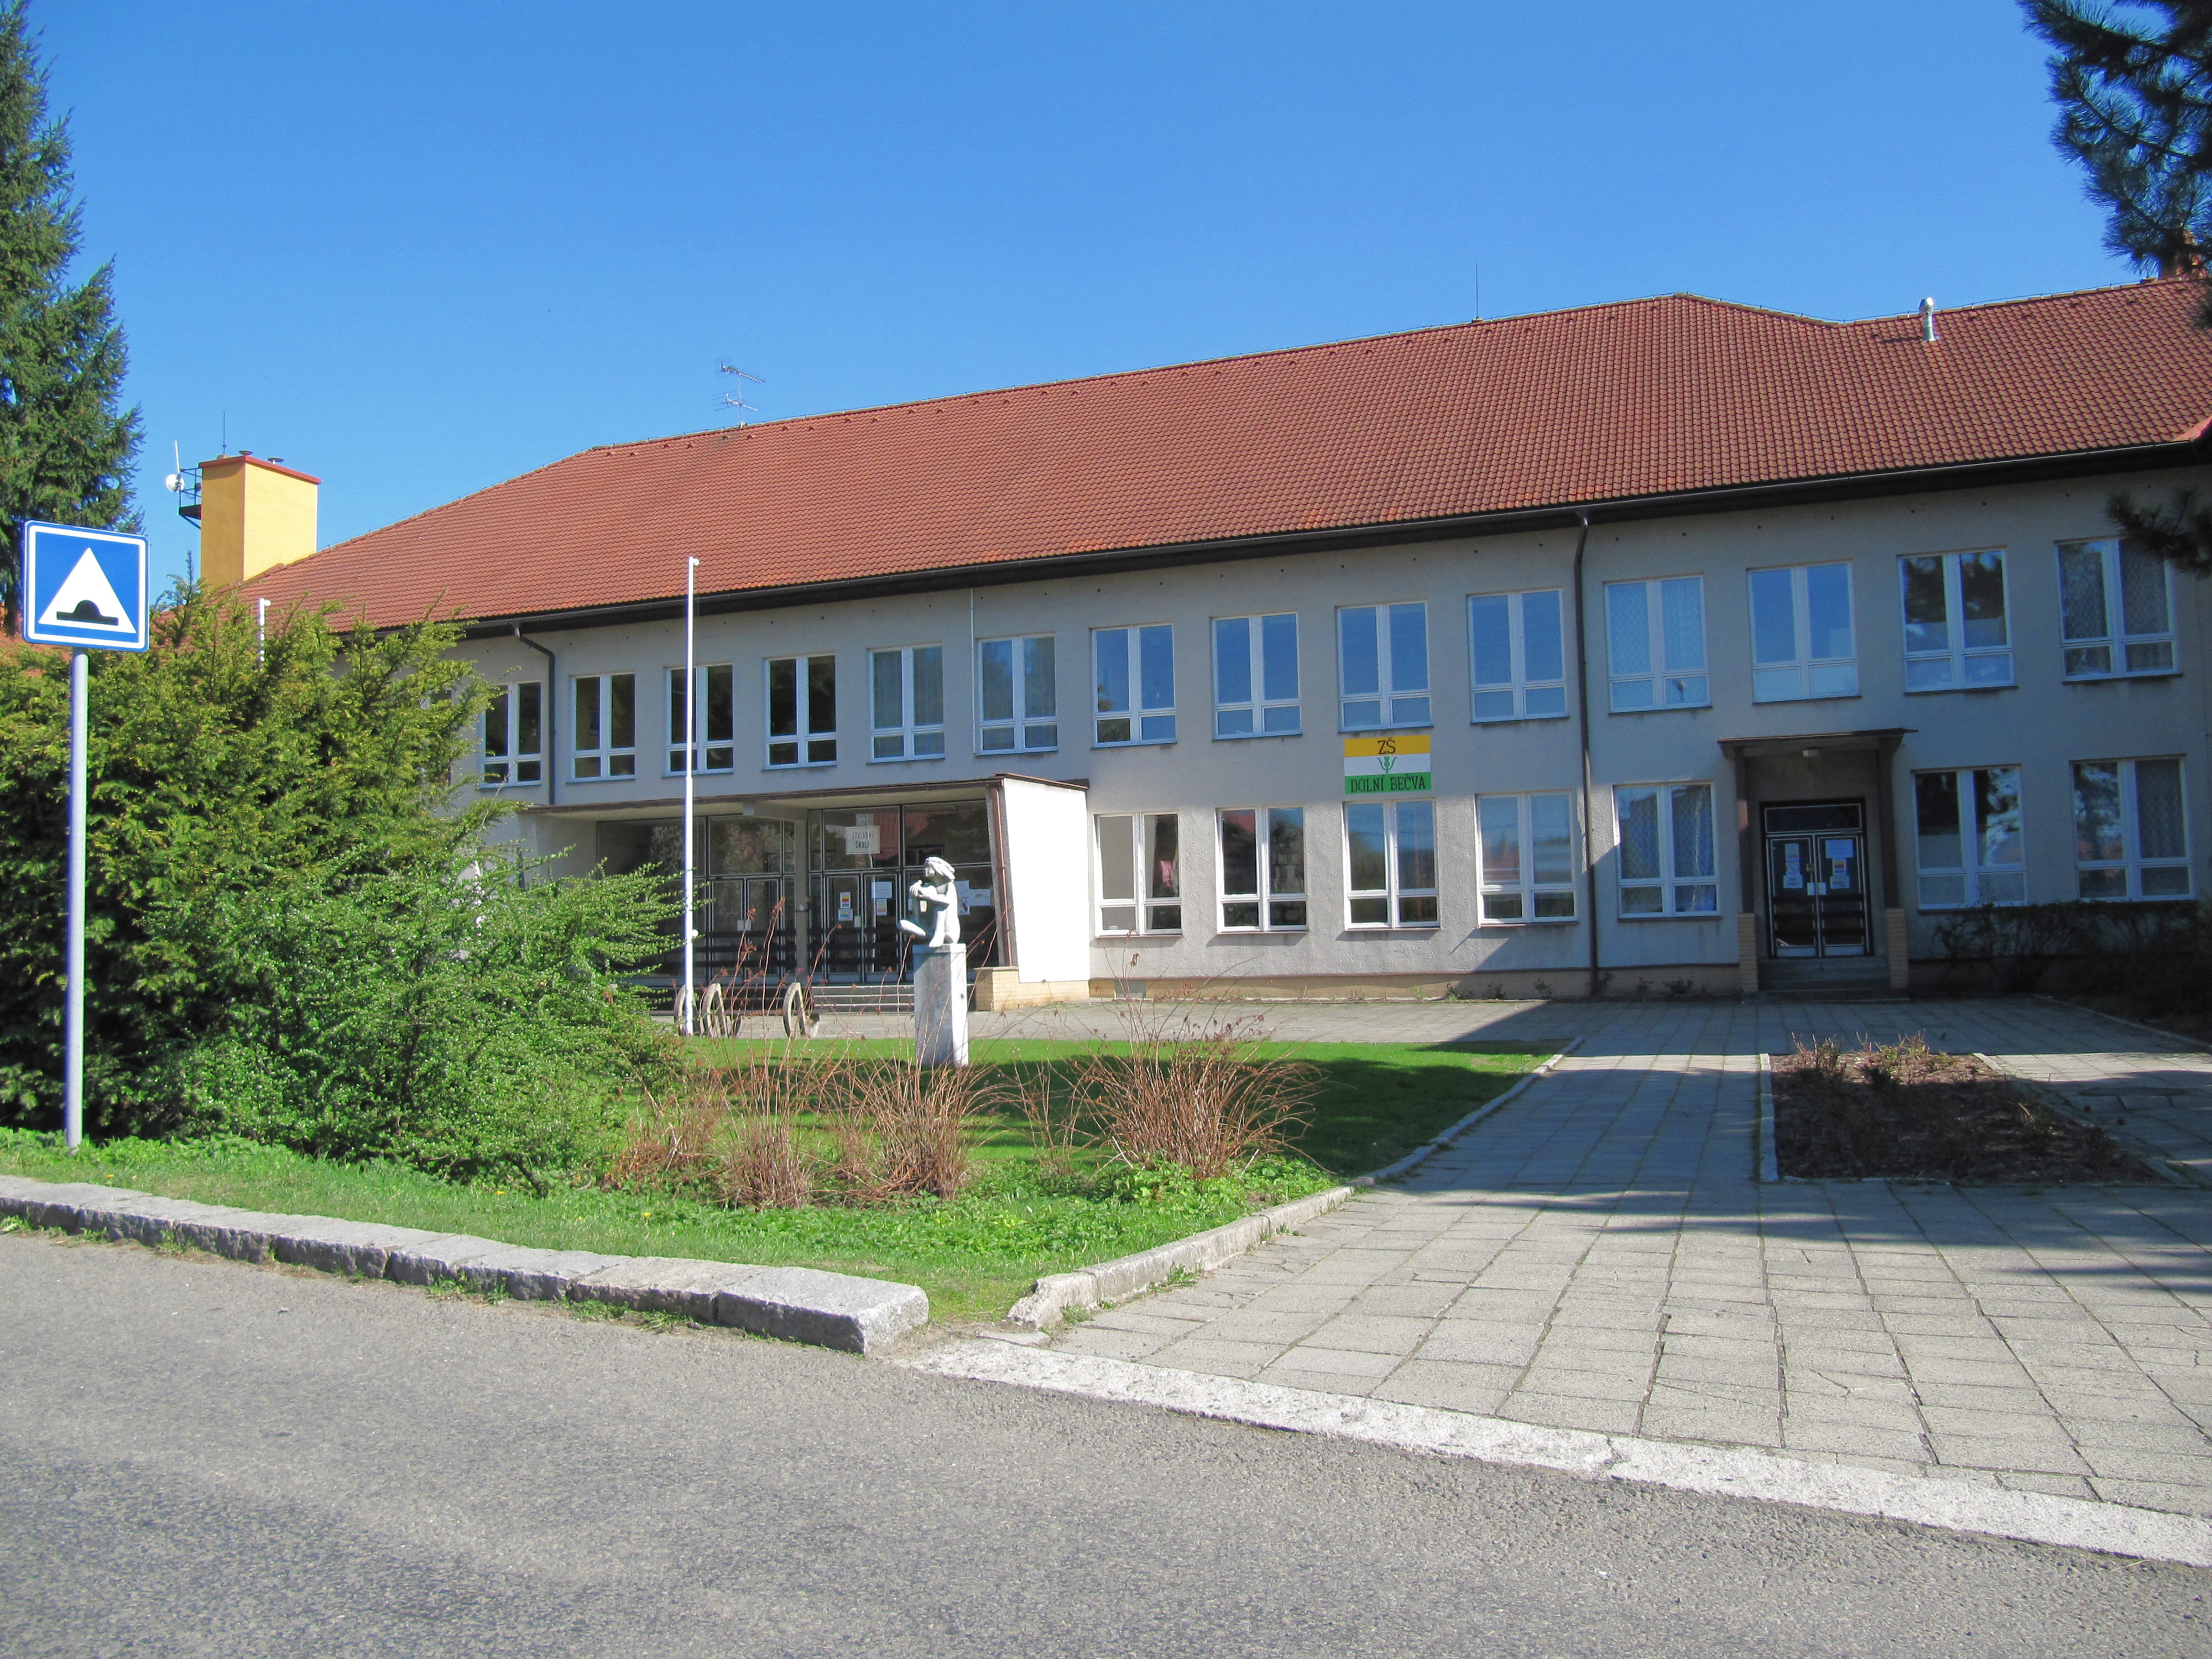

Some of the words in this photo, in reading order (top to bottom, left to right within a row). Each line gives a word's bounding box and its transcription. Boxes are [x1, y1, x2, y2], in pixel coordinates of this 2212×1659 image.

[1377, 737, 1396, 754] ZŠ
[1350, 775, 1385, 792] DOLNÍ
[1390, 773, 1426, 790] BEČVA
